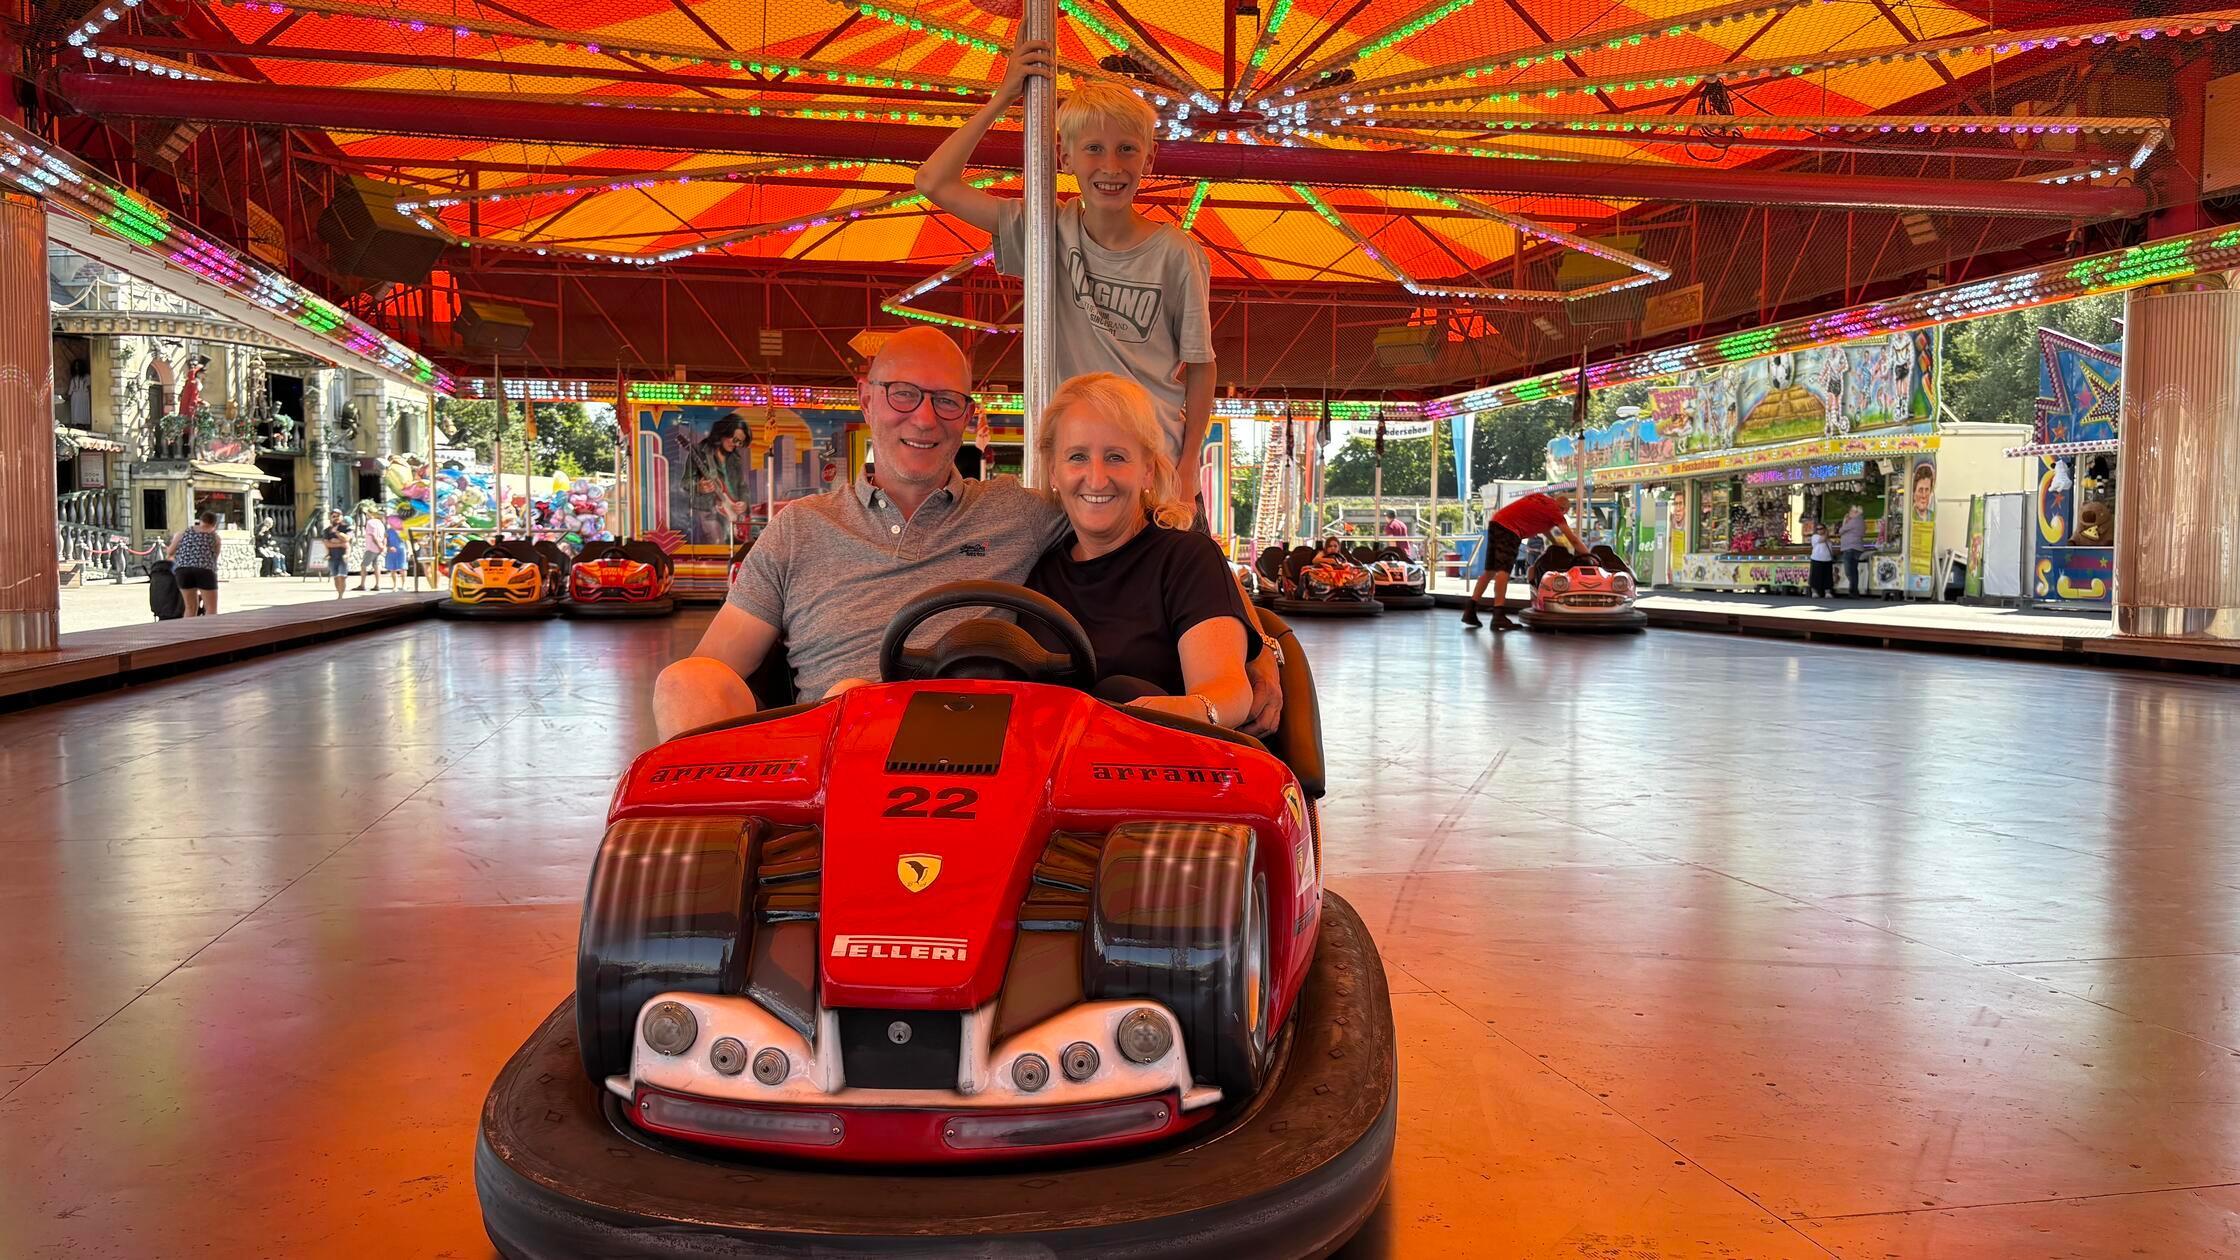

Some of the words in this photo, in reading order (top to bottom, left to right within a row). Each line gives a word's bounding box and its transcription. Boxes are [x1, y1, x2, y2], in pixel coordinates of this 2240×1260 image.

[1358, 426, 1372, 435] Auf
[1376, 425, 1427, 436] edersehen
[1672, 463, 1681, 474] Die
[1809, 463, 1841, 482] Super
[651, 762, 799, 783] arranni
[1093, 766, 1247, 785] arranni
[880, 786, 979, 820] 22
